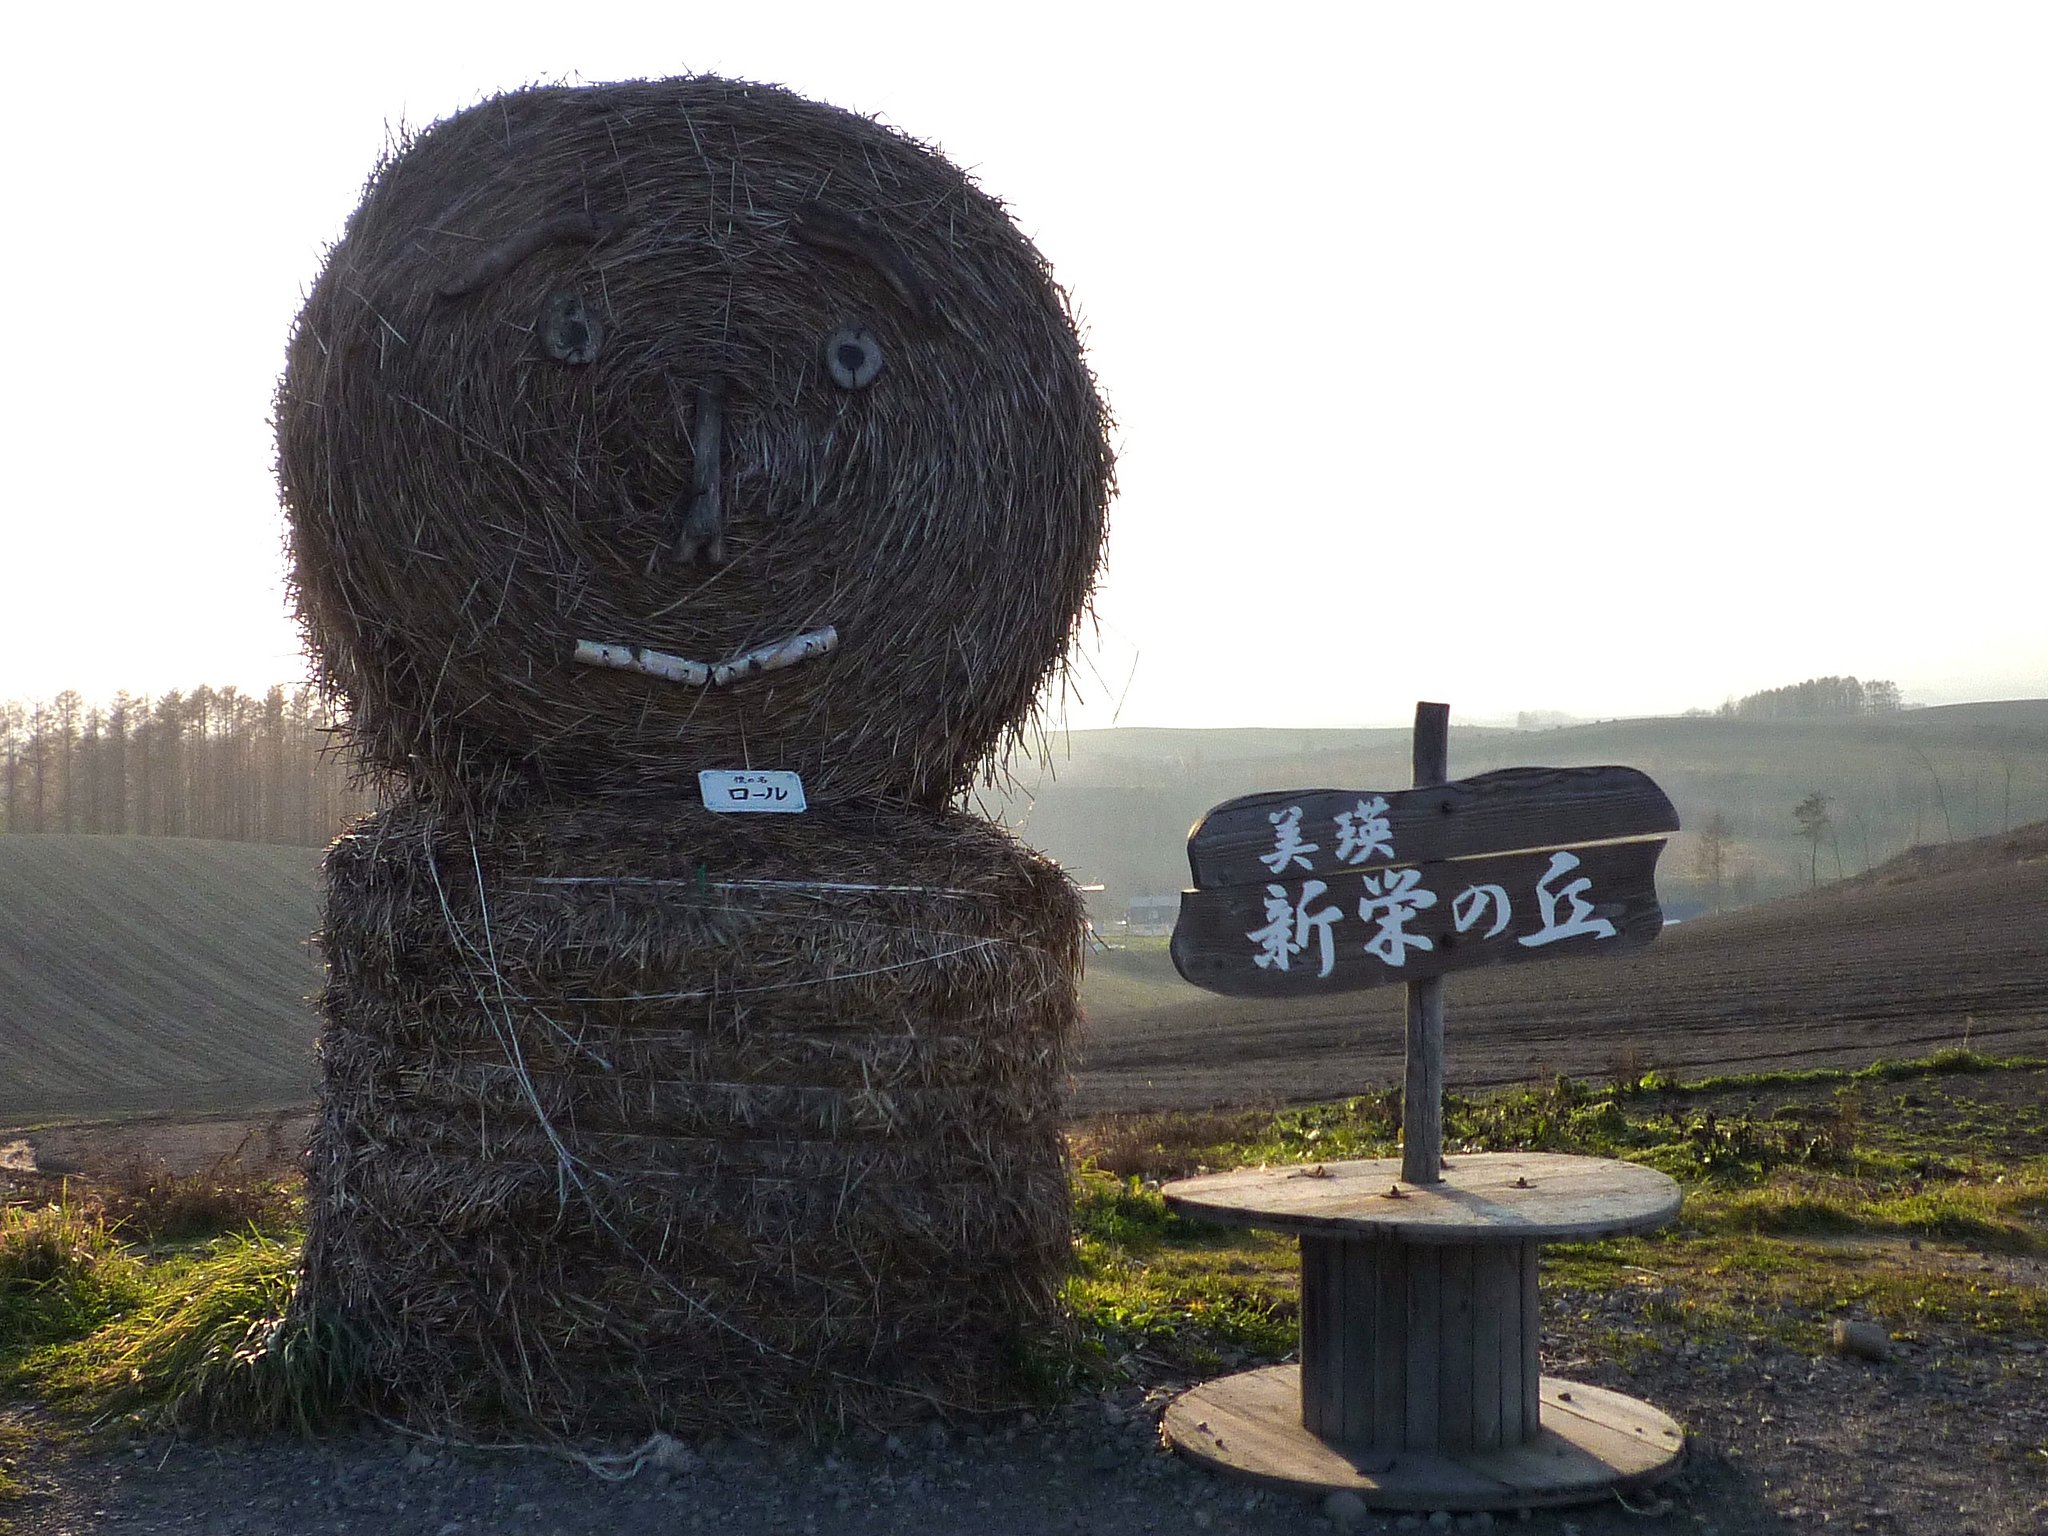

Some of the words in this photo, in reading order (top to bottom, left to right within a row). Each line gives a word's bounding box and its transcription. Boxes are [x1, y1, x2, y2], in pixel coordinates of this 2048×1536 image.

[728, 787, 788, 801] ロール
[1260, 796, 1395, 874] 美瑛
[1245, 851, 1618, 978] 新栄の丘
